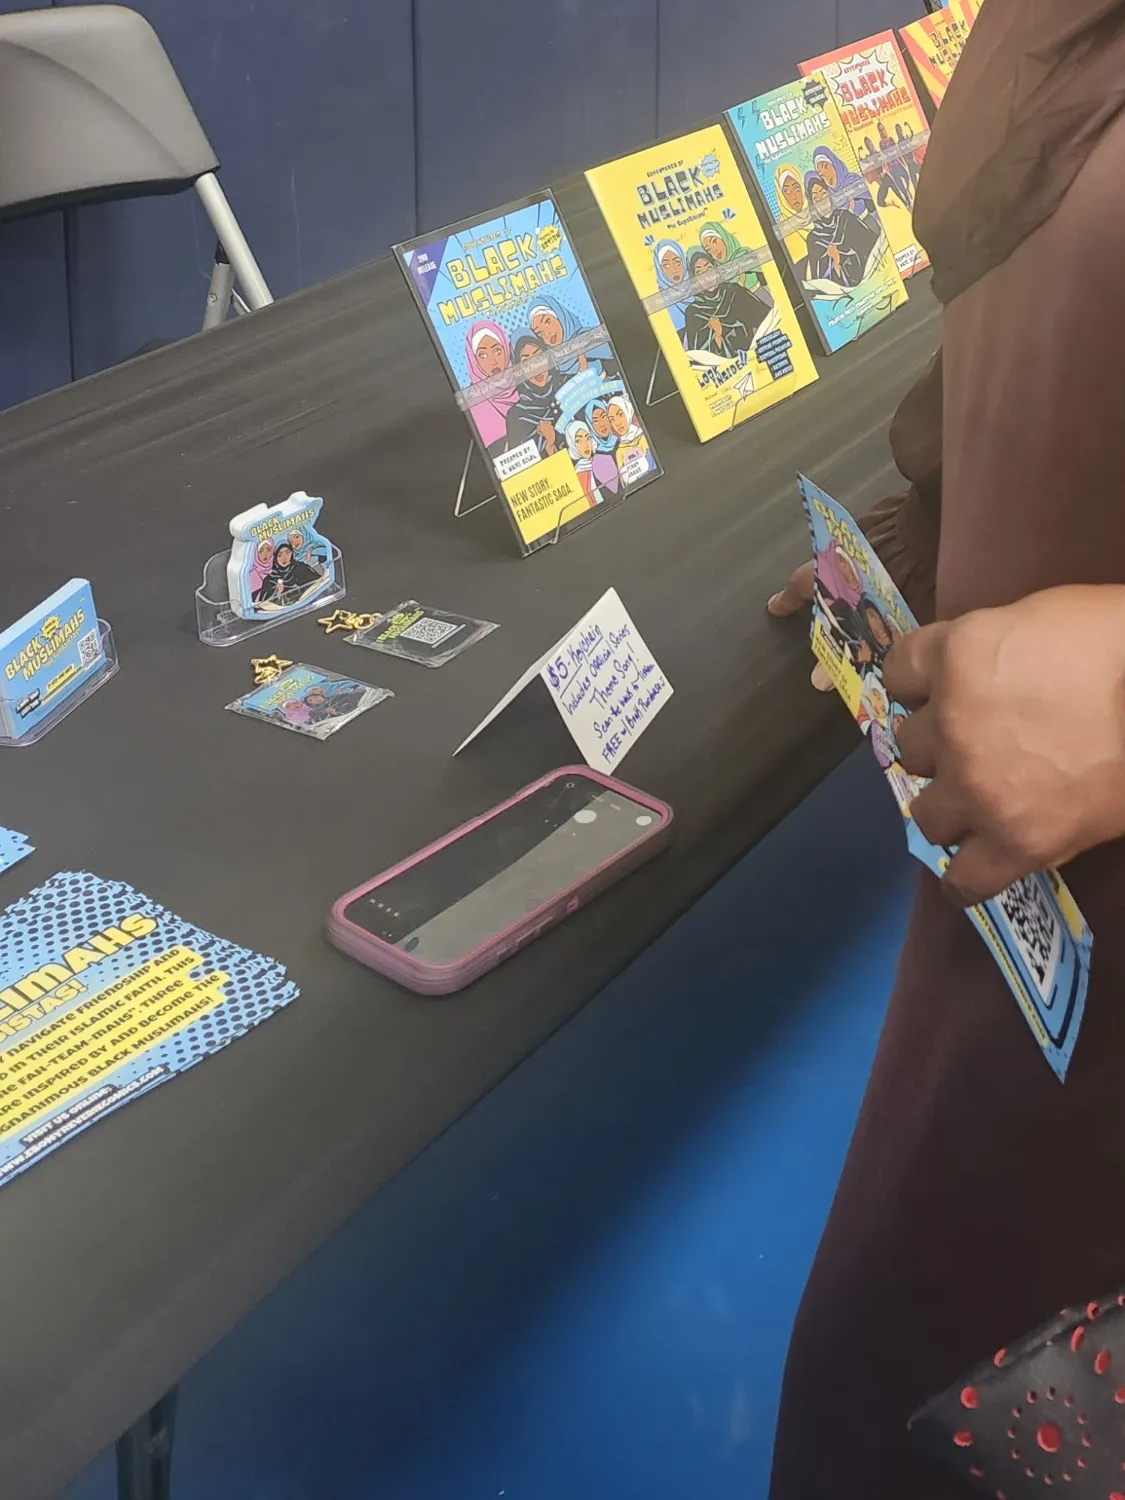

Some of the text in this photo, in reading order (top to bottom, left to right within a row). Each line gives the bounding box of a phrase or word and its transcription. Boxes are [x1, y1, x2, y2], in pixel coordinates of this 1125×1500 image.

[928, 19, 968, 50] BLACK
[840, 68, 888, 103] BLACK
[760, 96, 807, 131] BLACK
[755, 111, 831, 161] MUSLIMAHS
[636, 183, 724, 230] MUSLIMAHS
[637, 165, 704, 207] BLACK
[446, 232, 537, 290] BLACK
[437, 254, 568, 326] MUSLIMAHS
[696, 365, 718, 388] LOOK
[510, 477, 553, 509] NEW STORY.
[516, 483, 574, 522] FANTASTIC SAGA.
[251, 515, 280, 537] BLACK
[258, 507, 316, 543] MUSLIMAHS
[4, 635, 42, 681] BLACK
[21, 607, 86, 682] MUSLIMAHS
[562, 676, 590, 716] Includes
[609, 624, 630, 648] Series
[589, 675, 618, 710] Theme
[602, 732, 622, 764] FREE
[0, 912, 158, 1021] IMAHS
[6, 949, 180, 1057] NAVIGATE FRIENDSHIP AND
[9, 1060, 27, 1073] IN
[26, 1034, 70, 1062] THEIR
[69, 998, 126, 1036] ISLAMIC
[164, 957, 195, 975] THIS
[139, 979, 184, 1010] THREE
[22, 1058, 88, 1100] INSPIRED
[88, 1045, 108, 1060] BY
[110, 1027, 138, 1047] AND
[138, 991, 194, 1028] BECOME
[192, 974, 220, 993] THE
[0, 995, 214, 1134] GNANIMOUS BLACK MUSLIMAHS!
[22, 1120, 55, 1143] VISIT
[53, 1111, 71, 1125] US
